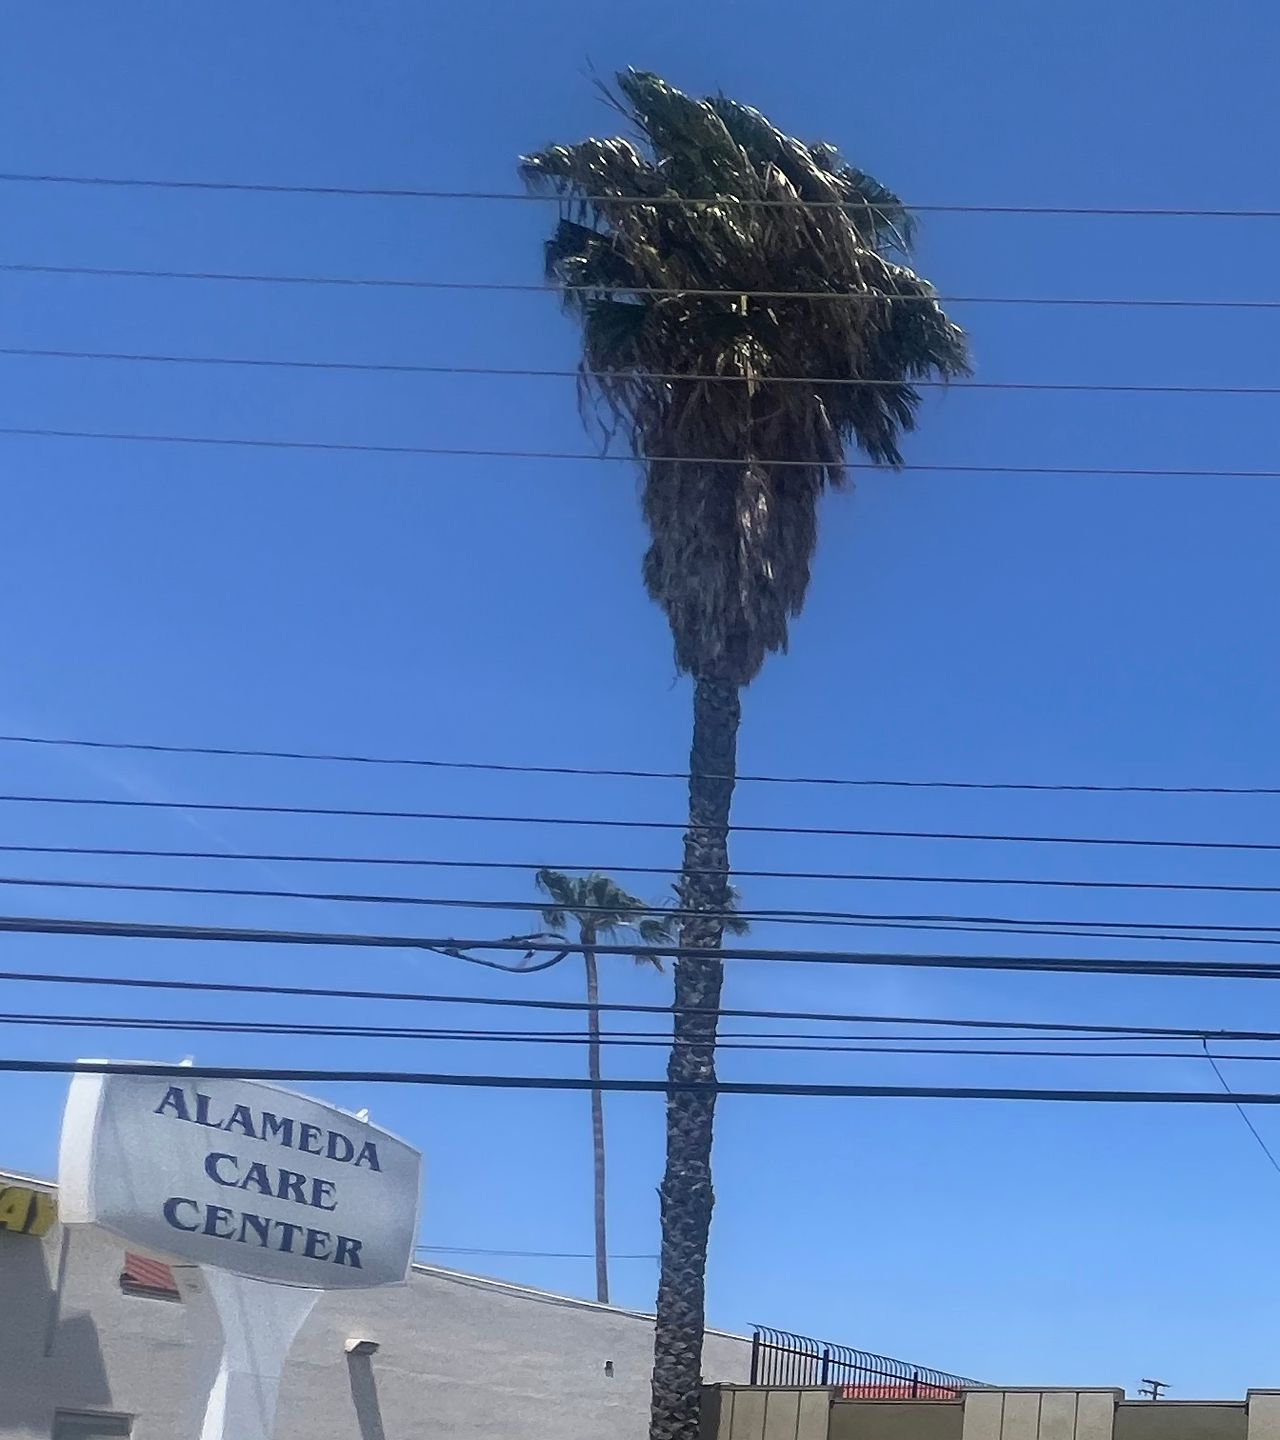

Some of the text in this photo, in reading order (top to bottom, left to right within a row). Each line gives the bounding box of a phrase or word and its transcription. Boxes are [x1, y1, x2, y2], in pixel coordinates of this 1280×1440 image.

[153, 1086, 383, 1172] ALAMEDA
[204, 1152, 338, 1211] CARE
[163, 1197, 363, 1269] CENTER
